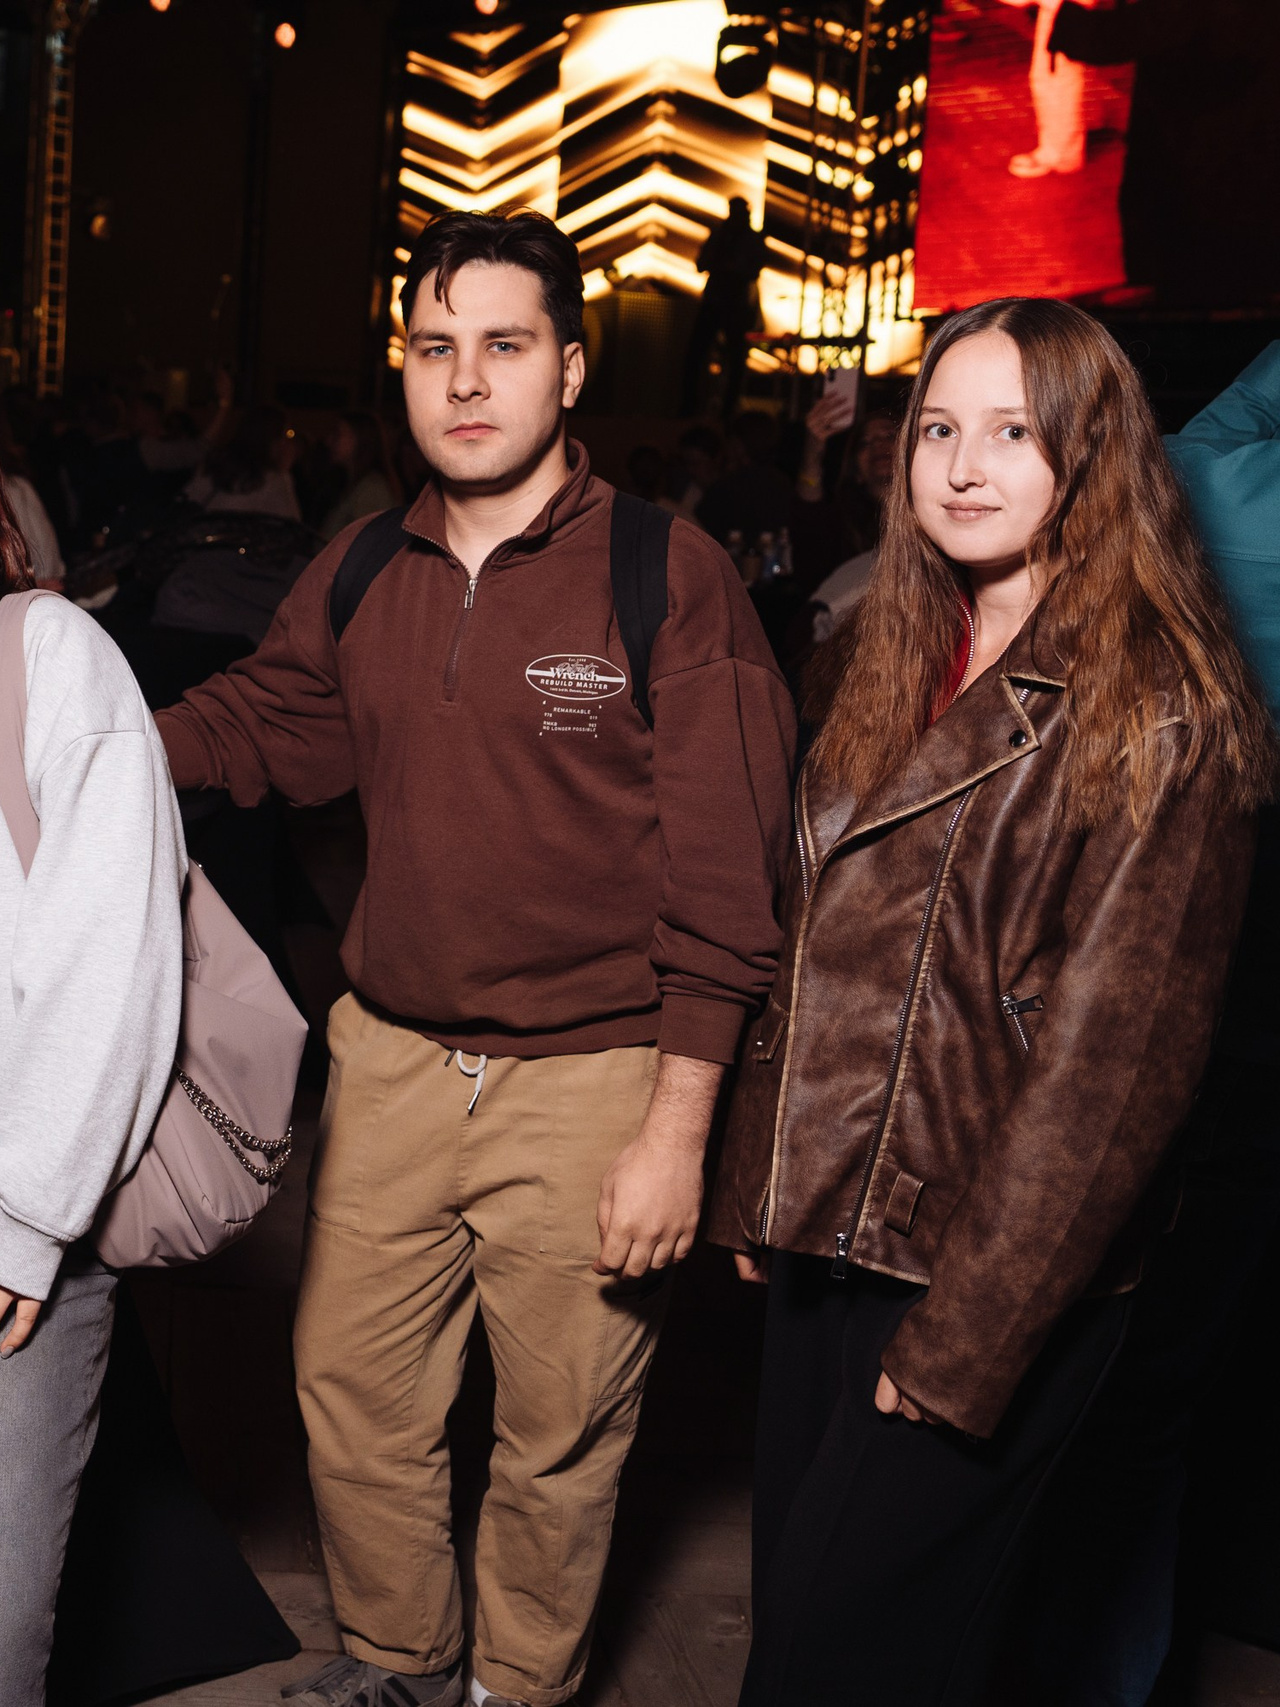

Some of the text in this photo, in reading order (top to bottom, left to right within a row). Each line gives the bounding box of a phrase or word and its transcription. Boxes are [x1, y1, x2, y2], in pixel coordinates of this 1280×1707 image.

[550, 667, 600, 682] Wrench
[576, 682, 608, 690] MASTER
[553, 707, 591, 715] REMARKABLE
